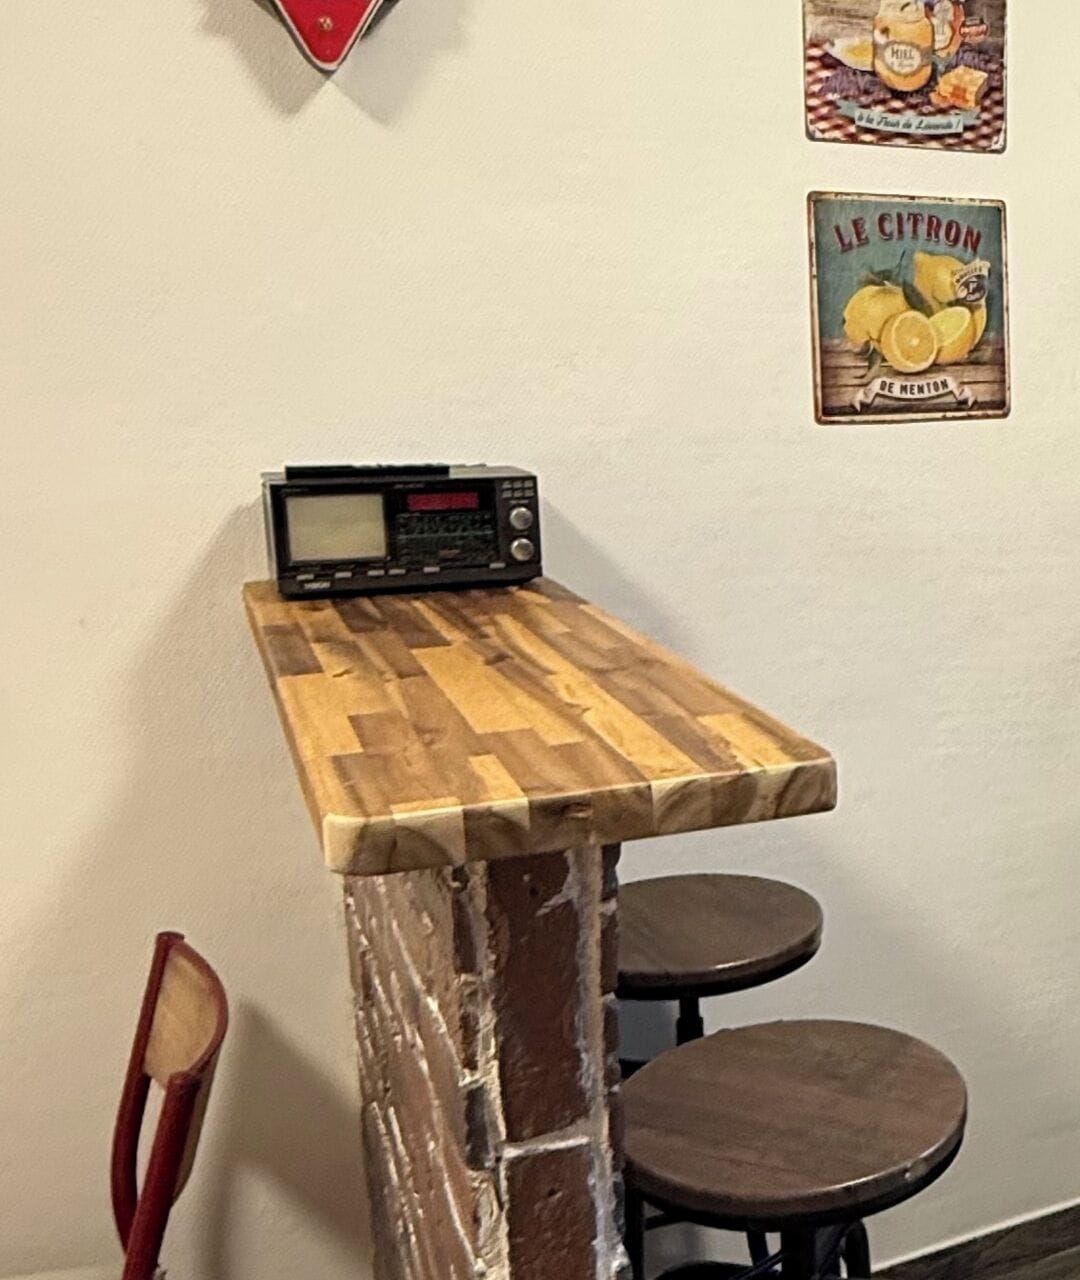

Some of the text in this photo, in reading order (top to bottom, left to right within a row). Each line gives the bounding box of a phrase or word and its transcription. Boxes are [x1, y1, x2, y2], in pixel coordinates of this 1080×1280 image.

[833, 212, 981, 254] LE CITRON
[880, 378, 949, 395] DE MENTON
